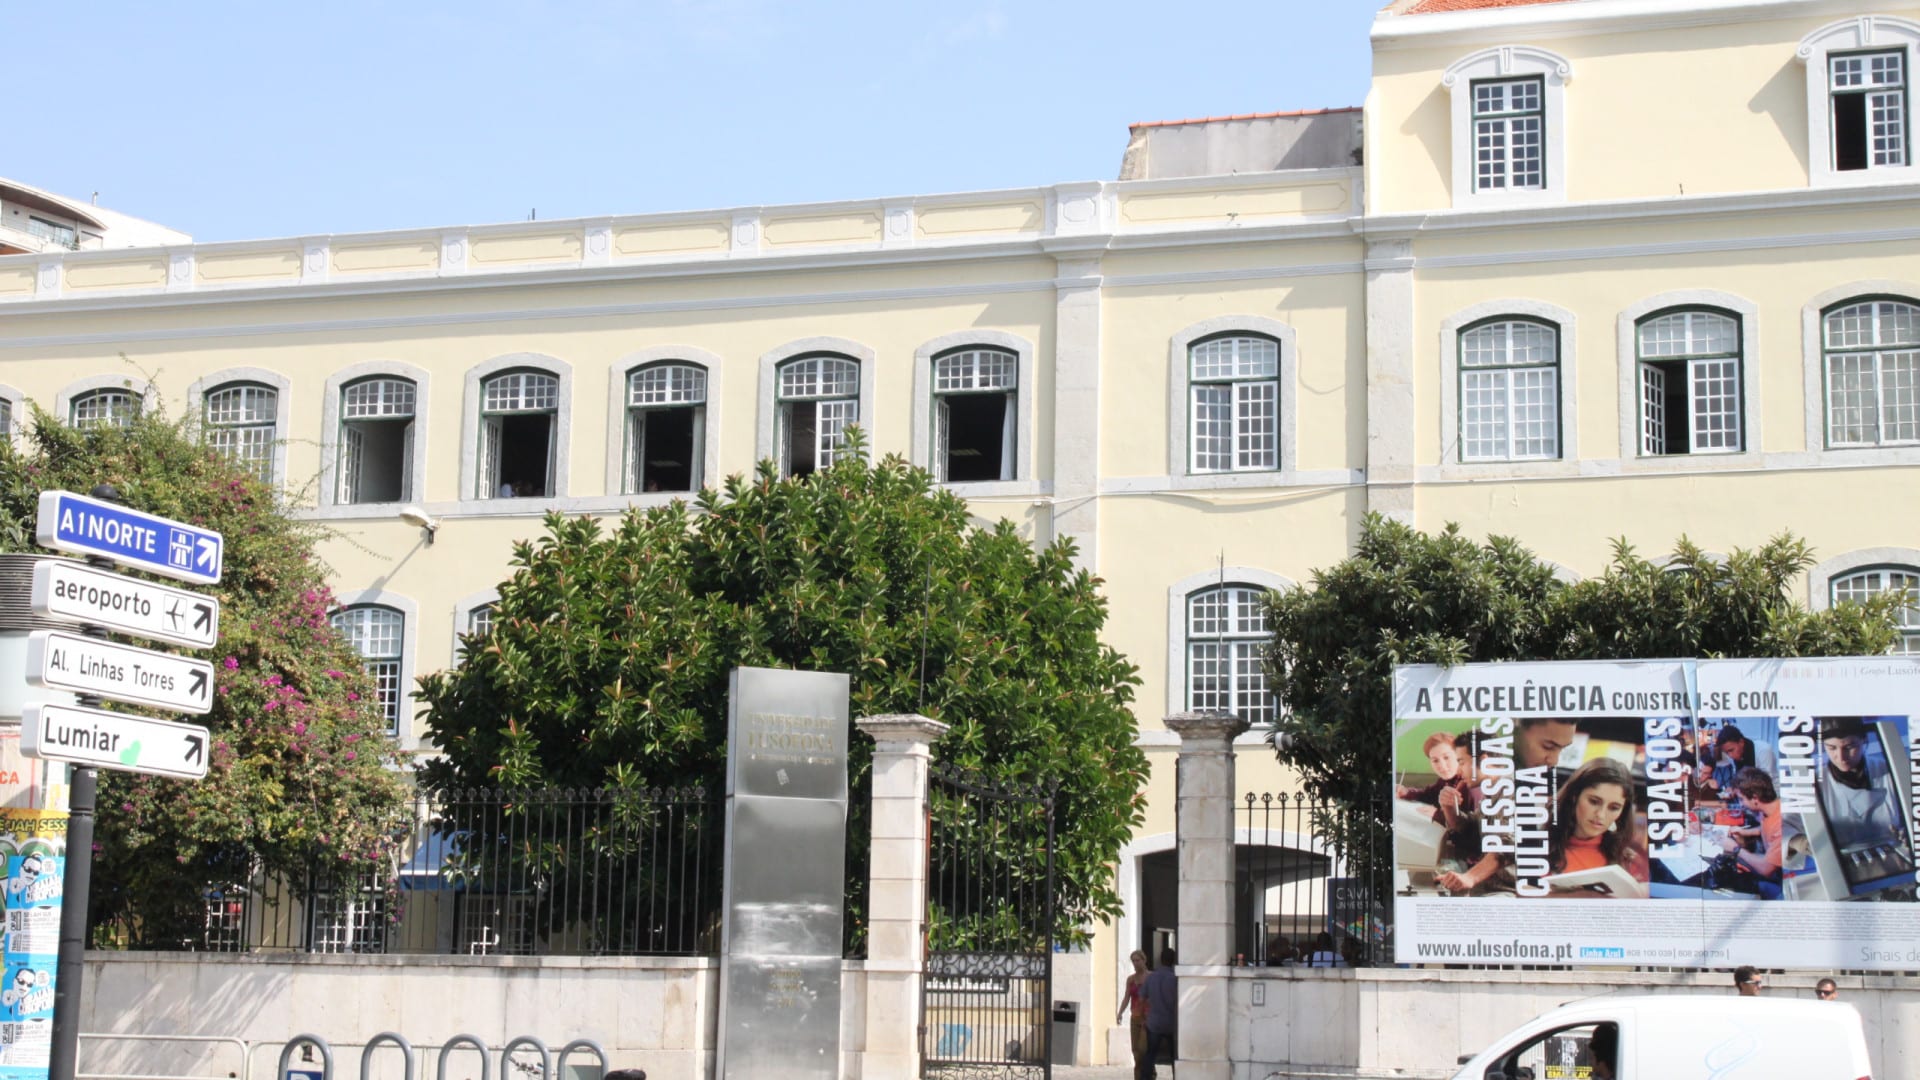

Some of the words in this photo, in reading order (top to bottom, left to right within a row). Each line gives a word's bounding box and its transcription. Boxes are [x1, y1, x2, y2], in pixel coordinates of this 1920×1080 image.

[55, 579, 151, 617] aeroporto
[51, 649, 70, 672] Al.
[80, 653, 124, 682] Linhas
[133, 664, 175, 691] Torres
[1415, 688, 1432, 712] A
[1442, 680, 1606, 712] EXCELÊNCIA
[1738, 691, 1796, 711] COM...
[44, 717, 121, 752] Lumiar
[1777, 716, 1816, 813] MEIOS
[1480, 717, 1515, 853] PESSOAS
[1645, 717, 1691, 859] ESPAÇOS
[9, 818, 36, 832] JAH
[1515, 765, 1550, 896] CULTURA
[1418, 939, 1573, 962] www.ulusofona.pt
[1861, 946, 1901, 962] Sinais
